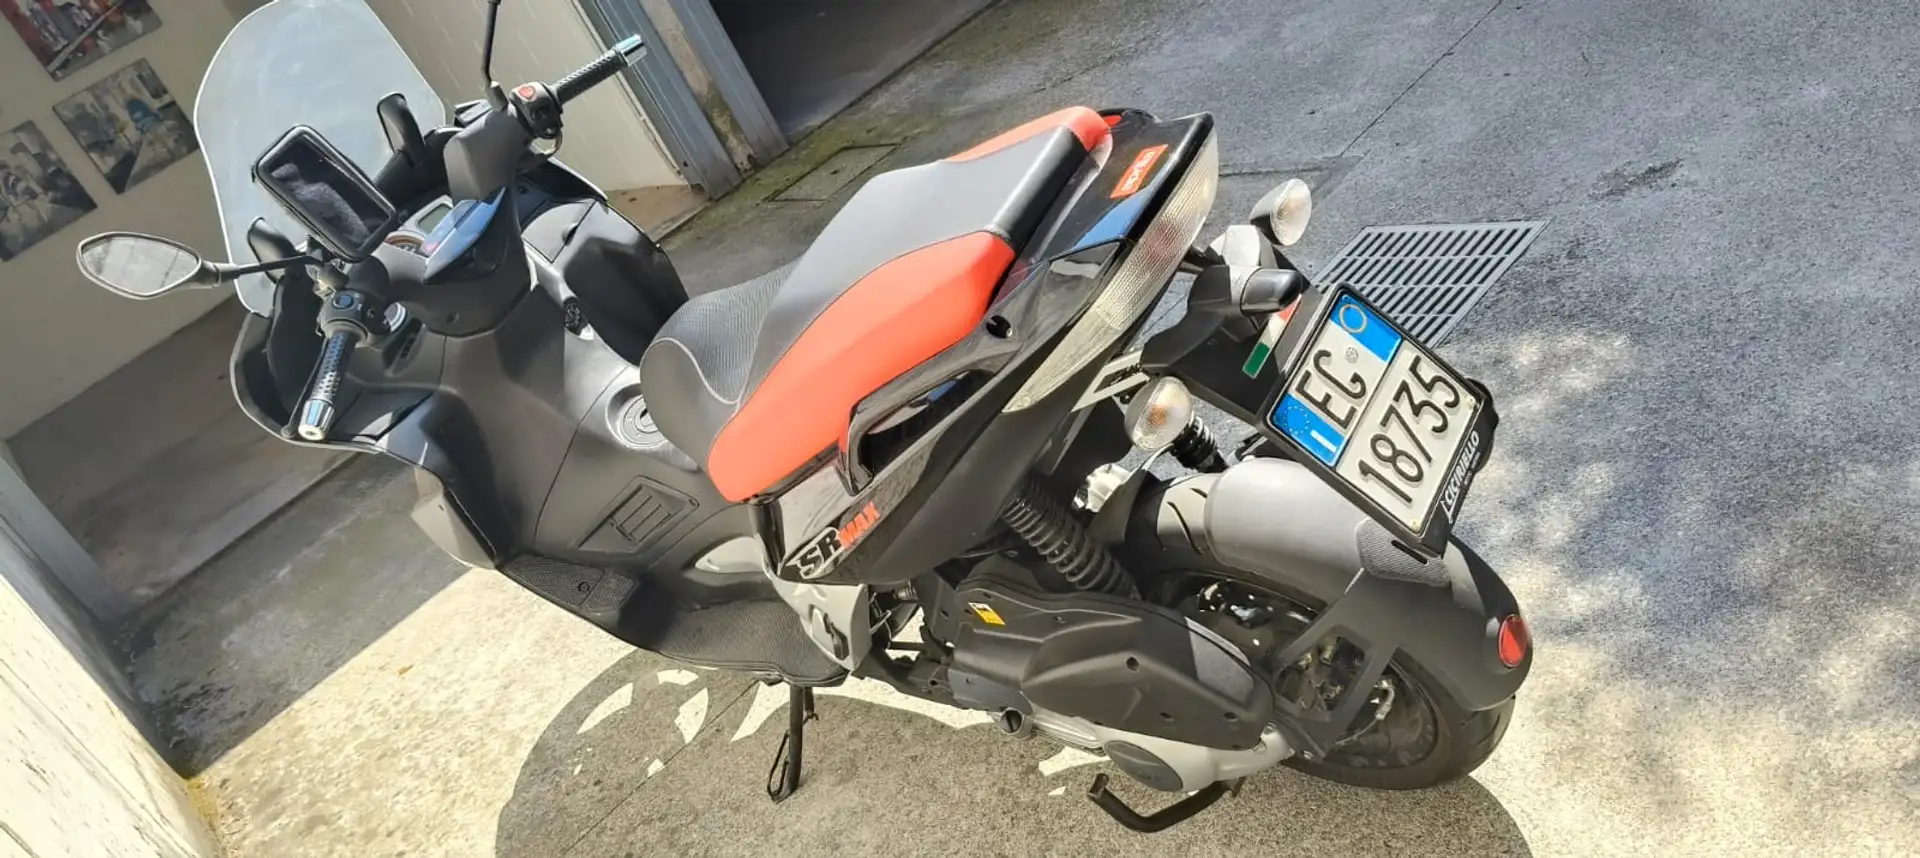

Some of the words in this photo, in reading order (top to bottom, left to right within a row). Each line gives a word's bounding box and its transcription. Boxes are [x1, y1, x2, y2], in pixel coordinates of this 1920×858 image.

[1295, 349, 1367, 429] EC
[1358, 355, 1460, 504] 18735
[797, 528, 844, 577] SR
[838, 500, 881, 551] MAX
